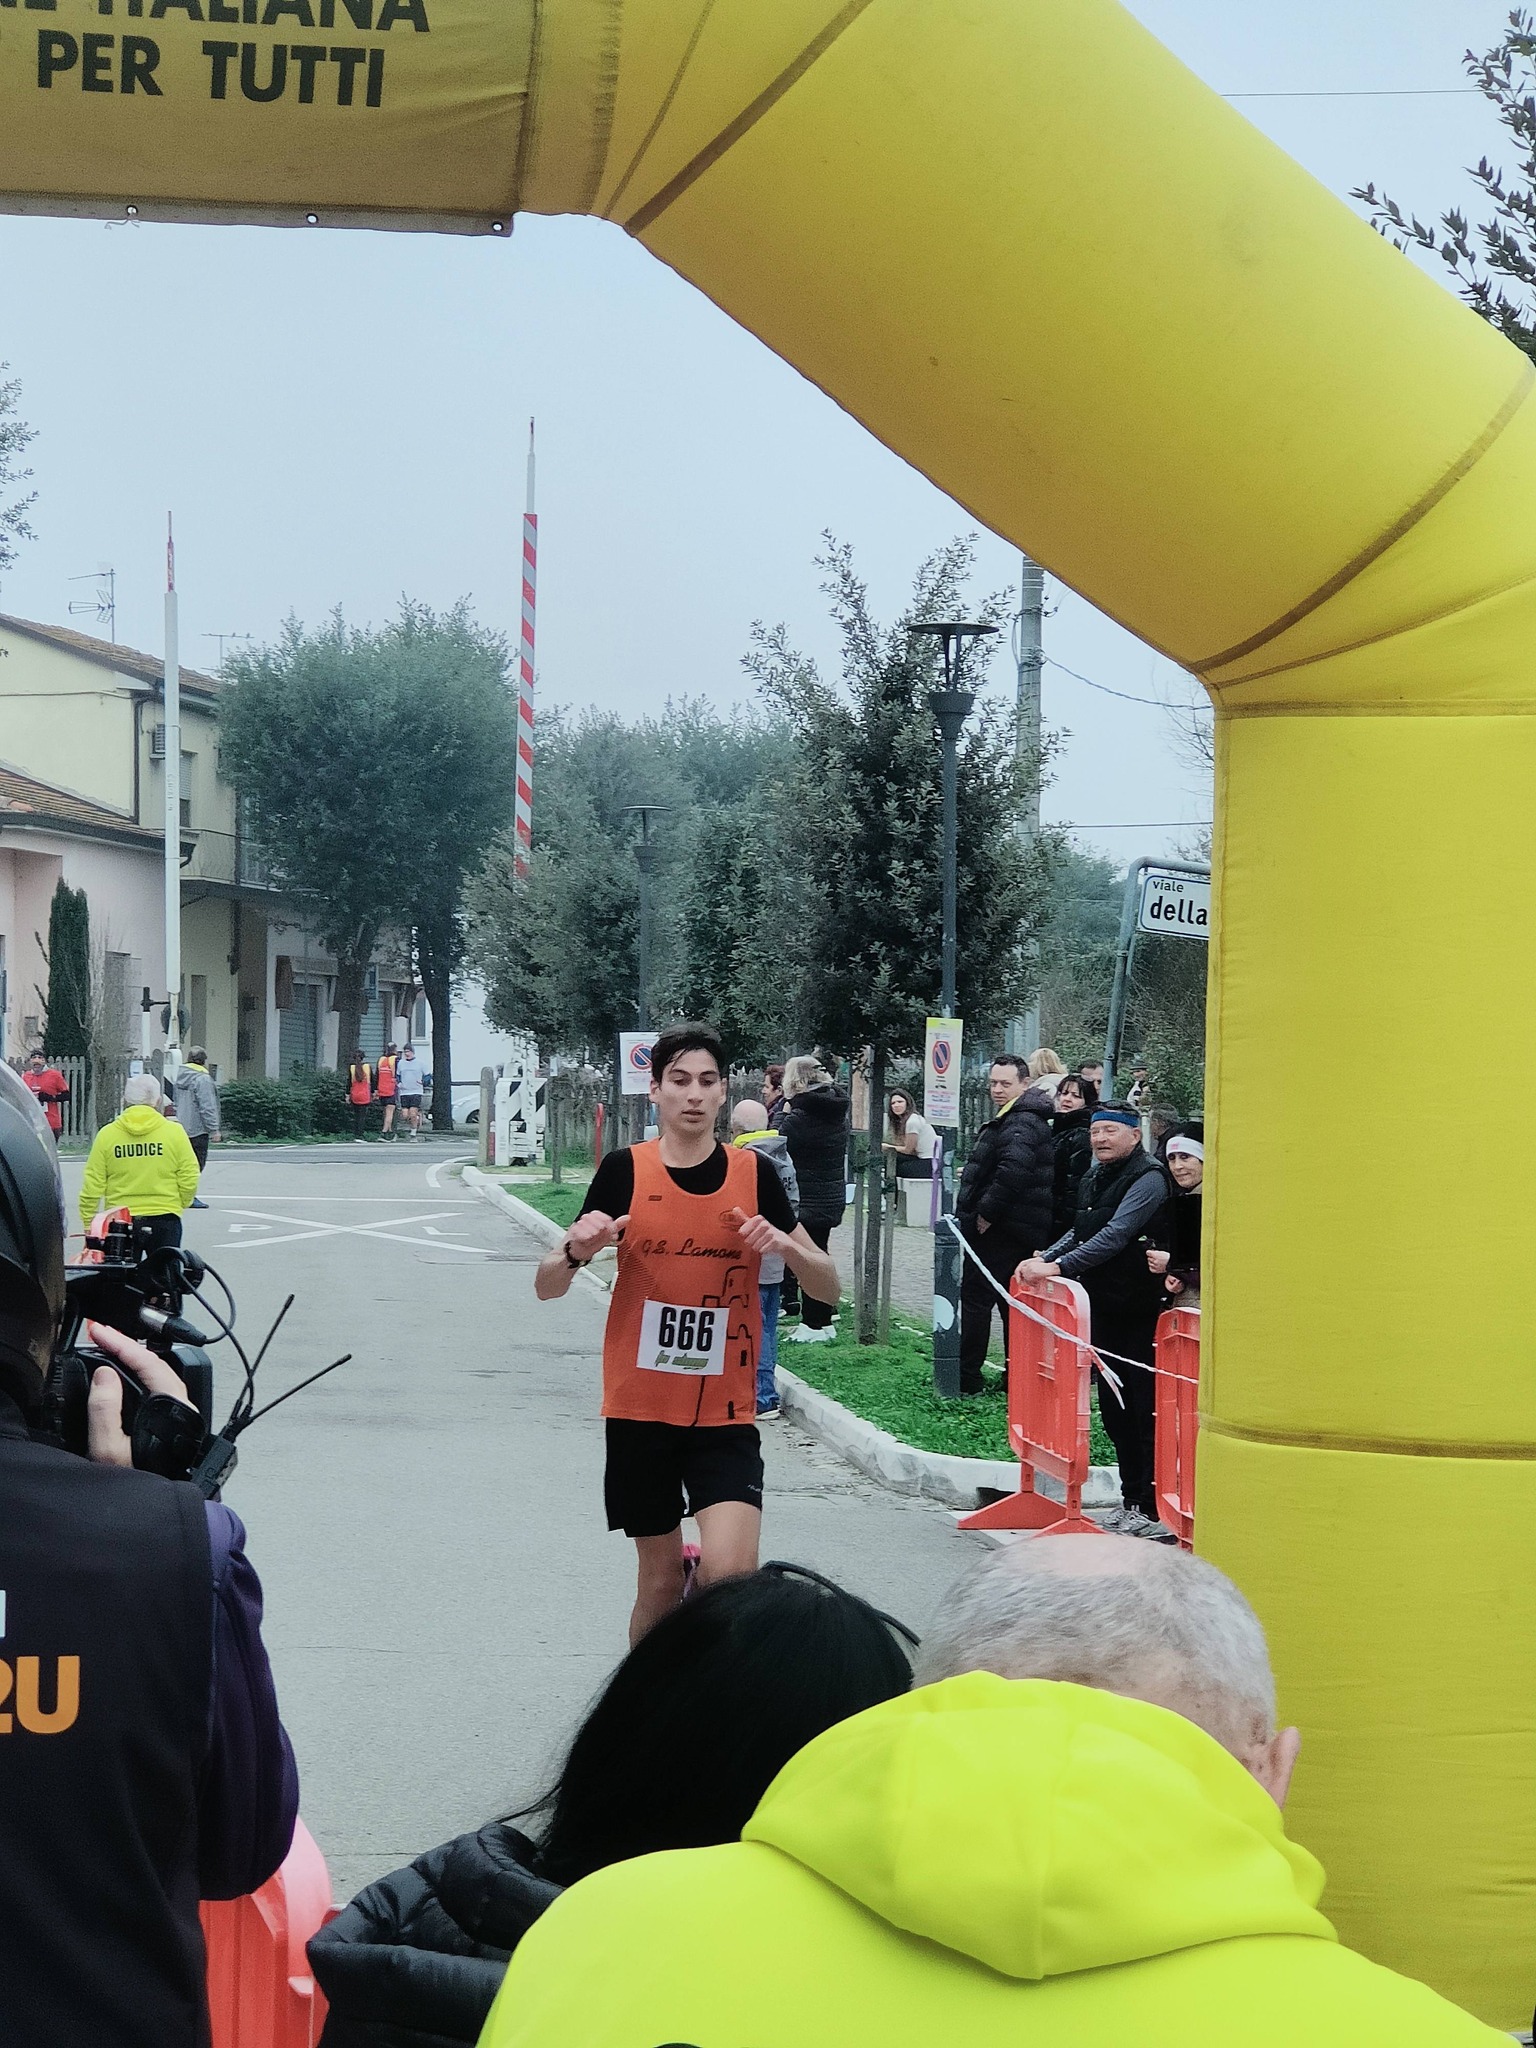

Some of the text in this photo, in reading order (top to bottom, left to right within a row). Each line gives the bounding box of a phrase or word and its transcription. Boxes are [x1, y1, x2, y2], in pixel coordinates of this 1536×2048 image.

[37, 29, 385, 108] PER TUTTI
[1153, 880, 1184, 893] viale
[1150, 895, 1208, 926] della
[114, 1143, 163, 1159] GIUDICE
[659, 1306, 715, 1352] 666
